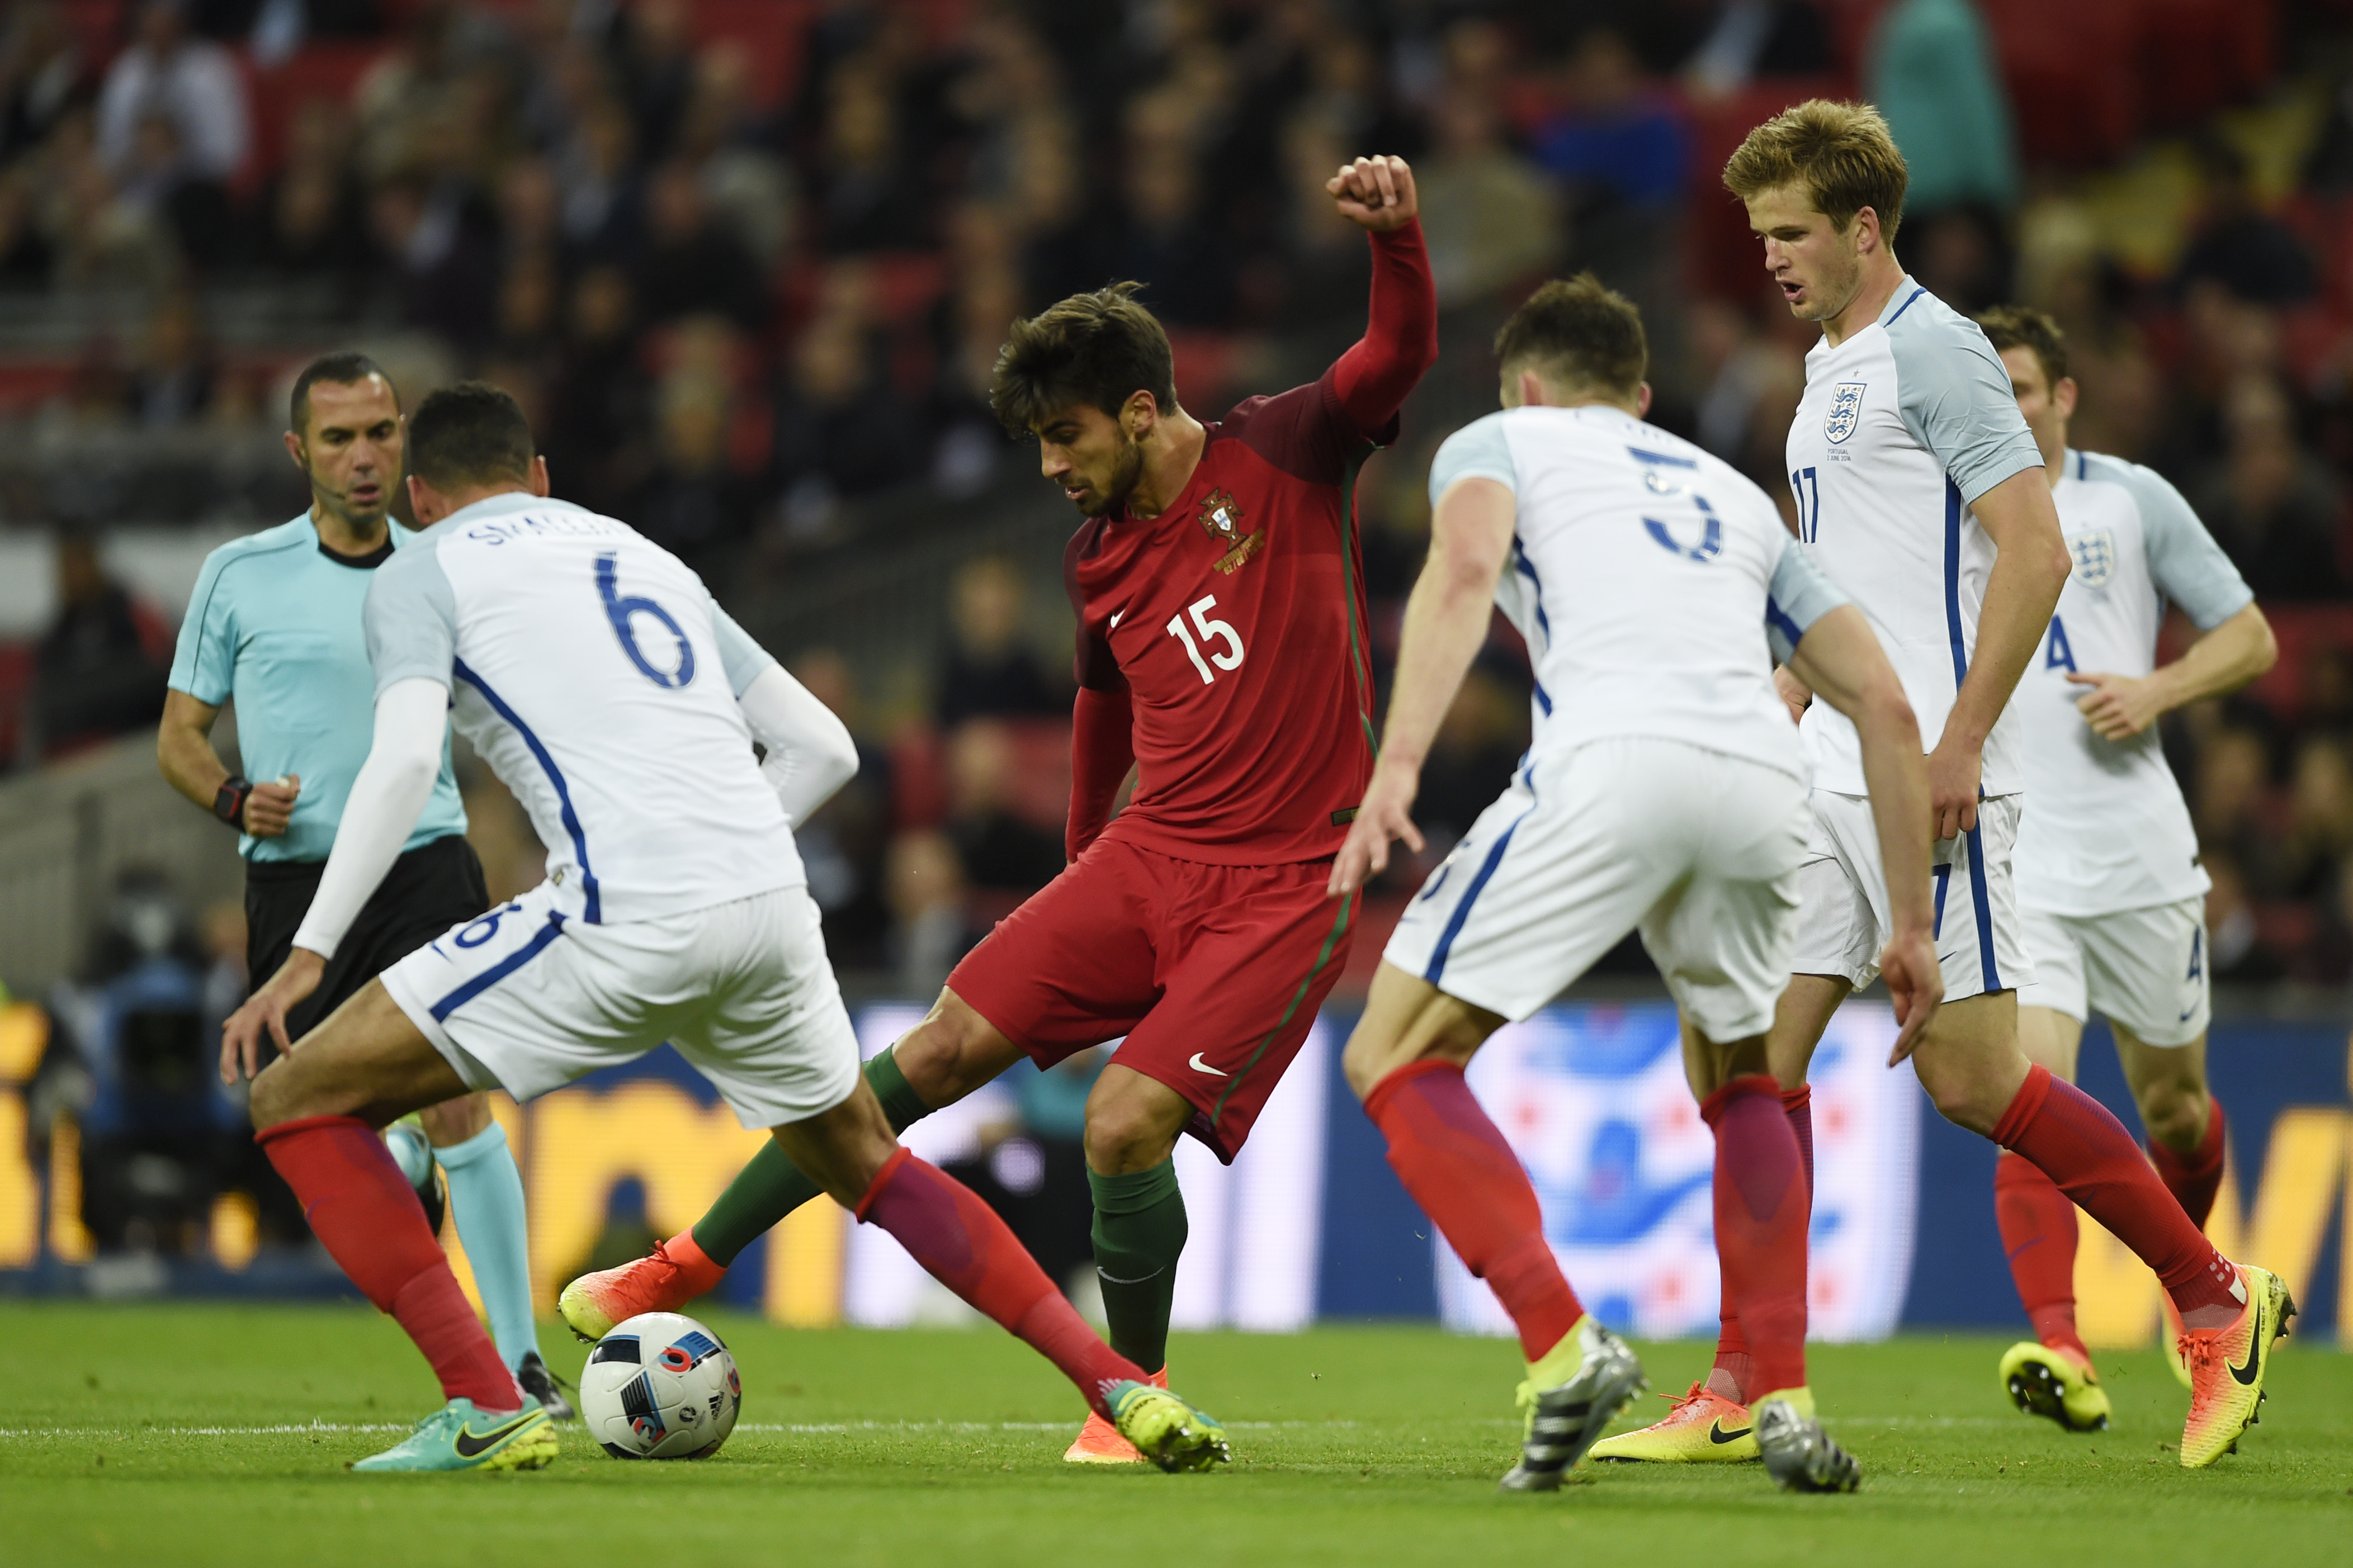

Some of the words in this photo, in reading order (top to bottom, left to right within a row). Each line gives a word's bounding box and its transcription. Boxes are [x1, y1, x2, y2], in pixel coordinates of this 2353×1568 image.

[1627, 446, 1723, 563] 5
[1792, 466, 1819, 544] 17
[593, 549, 697, 689] 6
[1166, 594, 1245, 685] 15
[2045, 614, 2077, 674] 4
[455, 904, 522, 949] 6
[1933, 863, 1953, 942] 7
[2185, 925, 2202, 986] 4
